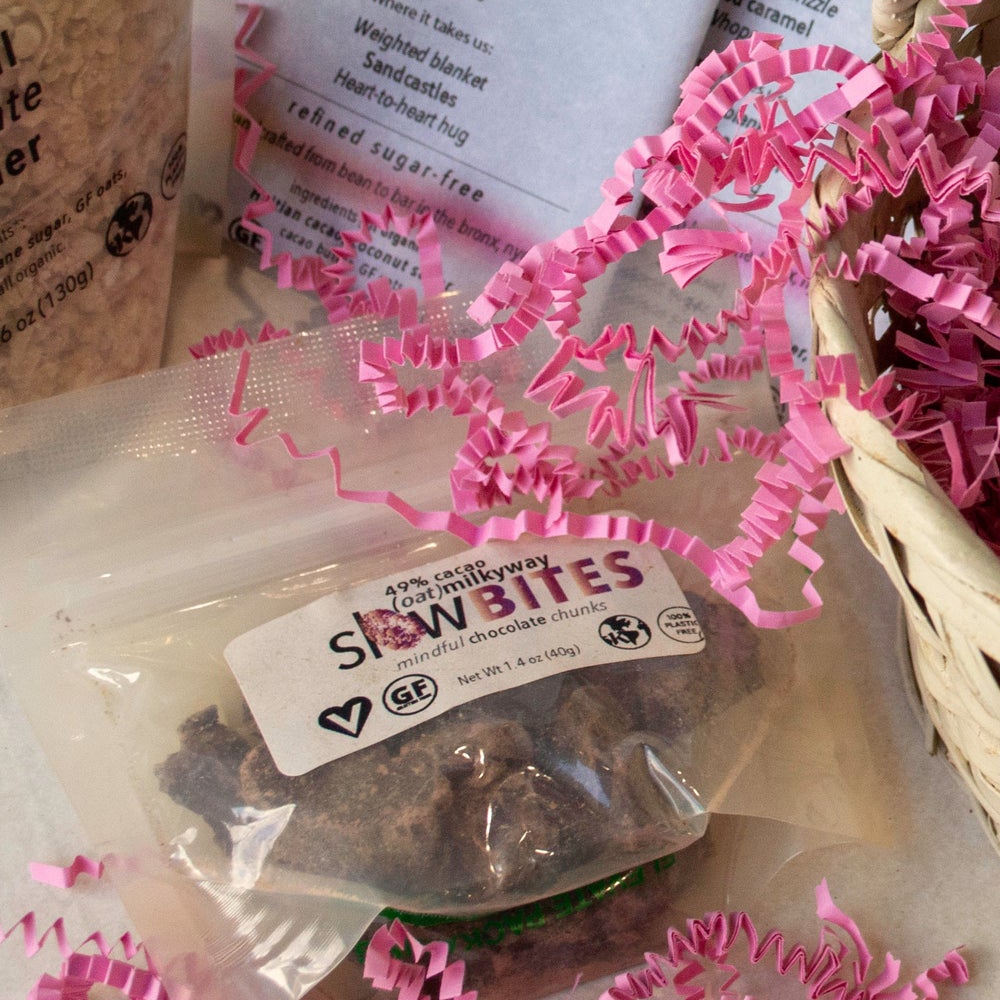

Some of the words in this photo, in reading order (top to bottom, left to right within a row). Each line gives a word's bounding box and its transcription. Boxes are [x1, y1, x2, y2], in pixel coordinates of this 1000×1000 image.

[354, 16, 431, 64] Weighted
[429, 51, 489, 92] blanket
[419, 9, 431, 27] it
[432, 17, 470, 46] takes
[472, 36, 494, 57] us:
[333, 67, 439, 132] Heart-to-heart
[437, 116, 470, 149] hug
[362, 50, 459, 109] Sandcastles
[287, 100, 366, 146] refined
[28, 212, 72, 249] sugar,
[76, 192, 93, 213] GF
[97, 168, 127, 197] oats,
[303, 147, 337, 174] from
[337, 161, 372, 191] bean
[373, 181, 390, 198] to
[390, 188, 415, 210] bar
[433, 208, 457, 230] the
[456, 217, 501, 252] bronx,
[16, 310, 37, 332] oz
[37, 261, 94, 318] (130g)
[358, 263, 378, 279] GF
[384, 576, 430, 598] 49%
[434, 559, 486, 582] cacao
[396, 636, 466, 672] mindful
[468, 613, 548, 646] chocolate
[550, 600, 608, 623] chunks
[666, 612, 691, 620] 100%
[457, 671, 482, 687] Net
[481, 663, 504, 679] Wt
[504, 657, 526, 673] 1.4
[528, 653, 544, 665] oz
[544, 644, 582, 662] (40g)
